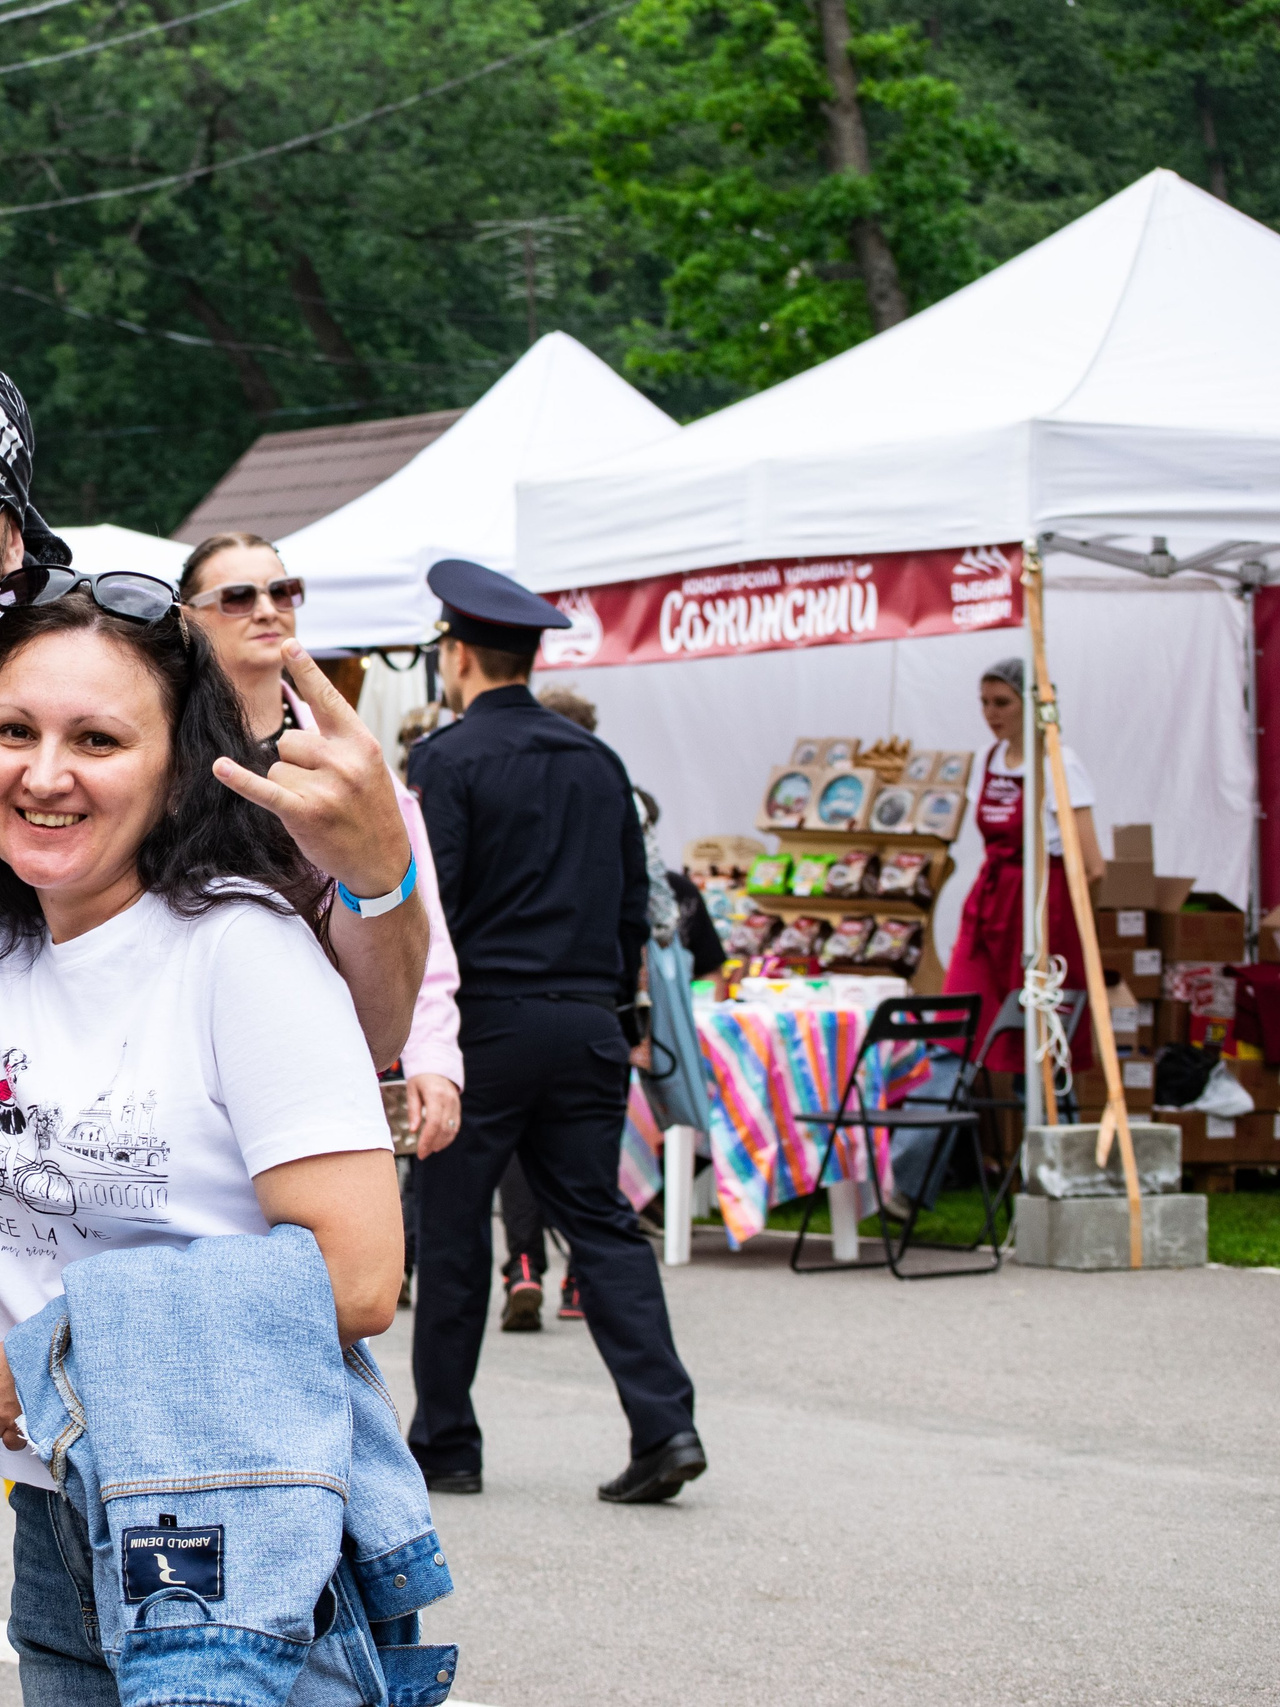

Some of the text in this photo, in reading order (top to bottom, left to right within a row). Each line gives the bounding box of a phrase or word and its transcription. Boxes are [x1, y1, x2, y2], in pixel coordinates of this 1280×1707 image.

[659, 564, 879, 654] Сажинский
[31, 1222, 59, 1246] LA
[73, 1223, 112, 1241] VIE
[130, 1536, 211, 1549] ARNOLD DENIM
